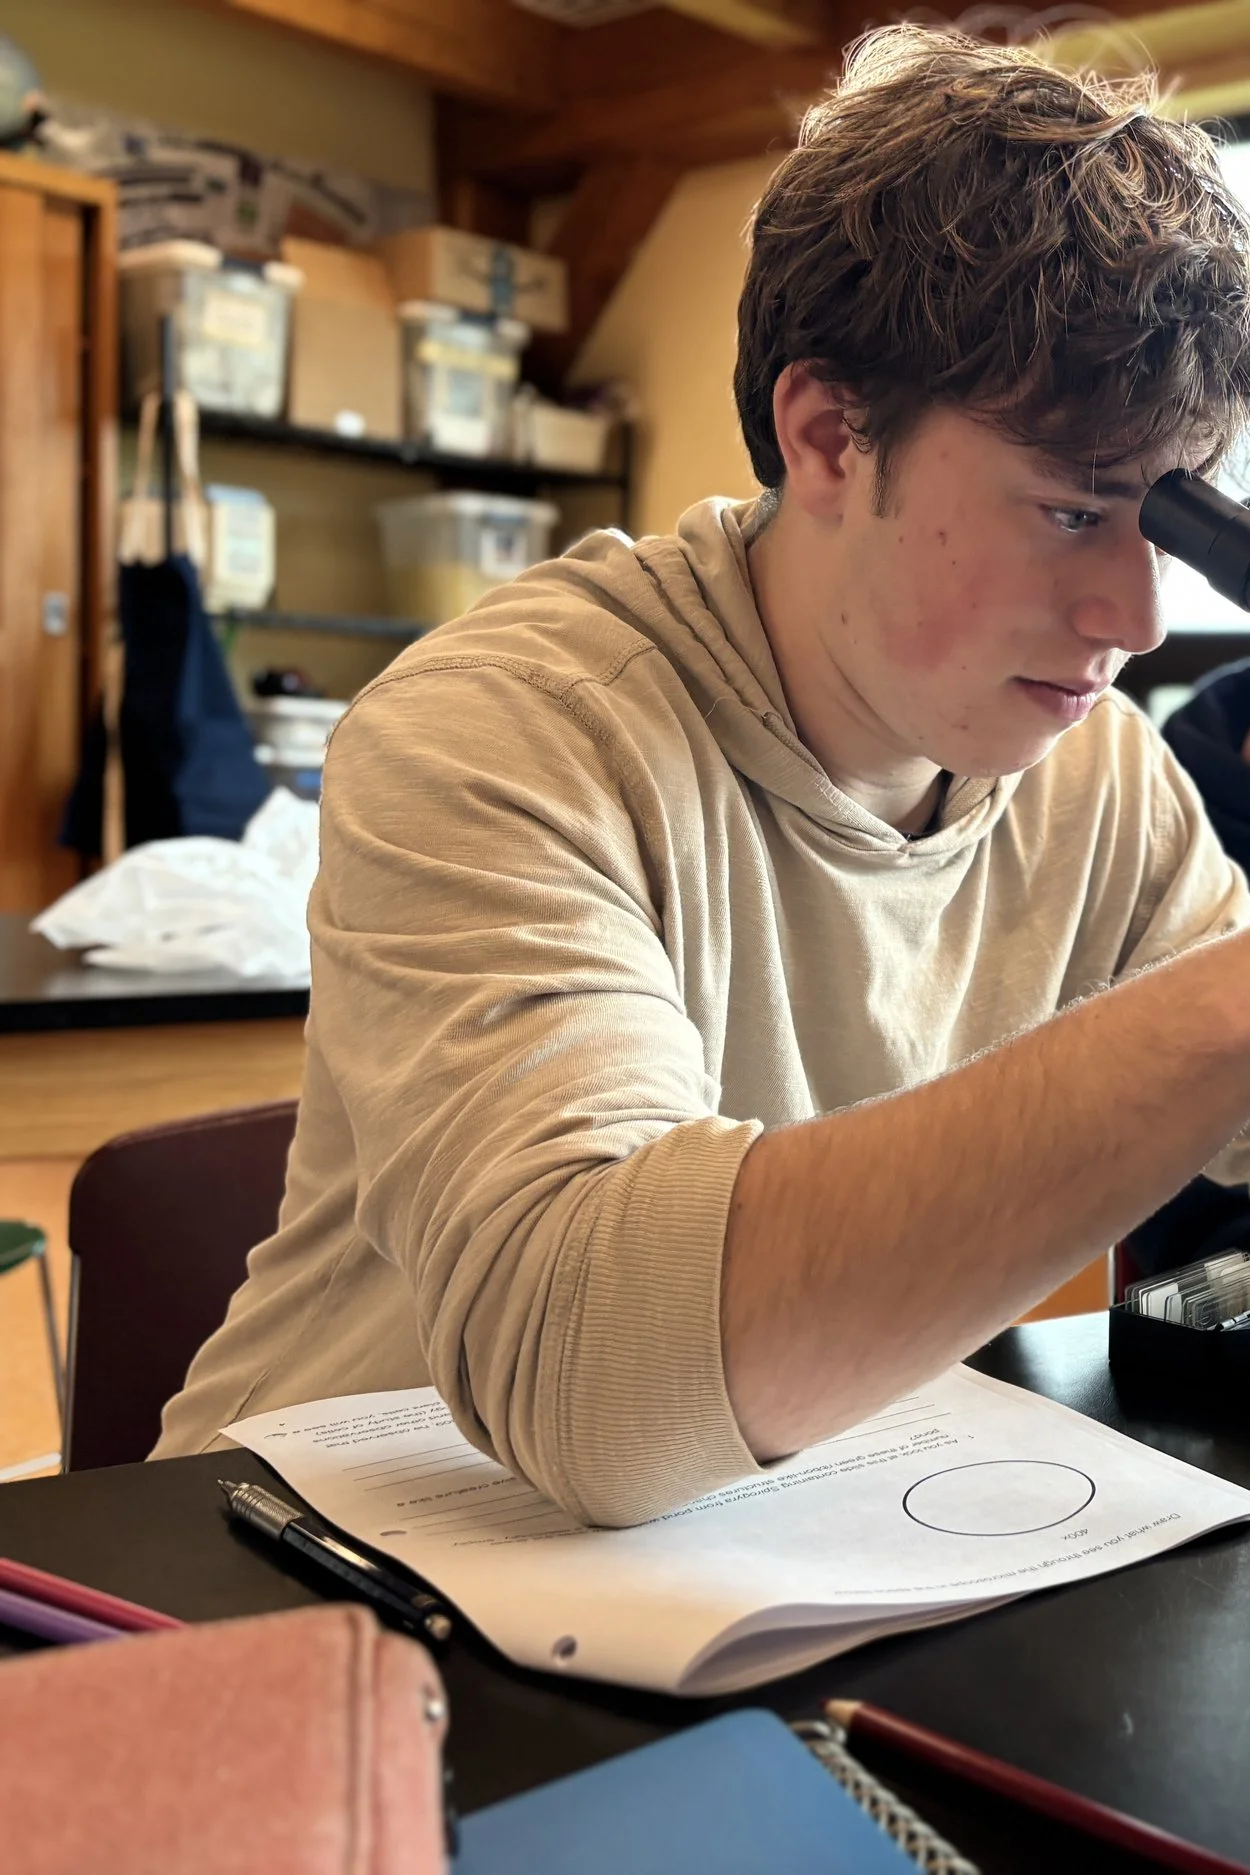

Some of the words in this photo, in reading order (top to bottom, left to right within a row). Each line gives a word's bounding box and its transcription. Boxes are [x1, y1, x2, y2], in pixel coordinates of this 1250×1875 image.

[312, 1425, 392, 1444] observations
[352, 1428, 410, 1444] observed
[912, 1434, 949, 1448] number
[326, 1440, 350, 1449] that
[923, 1441, 943, 1452] you
[834, 1454, 866, 1466] green
[867, 1448, 898, 1458] these
[900, 1448, 922, 1458] look
[839, 1462, 865, 1475] slide
[866, 1456, 886, 1468] this
[777, 1463, 833, 1484] ribbon-like
[780, 1470, 838, 1489] containing
[718, 1478, 775, 1496] structures
[724, 1485, 780, 1504] Spirogyra
[695, 1500, 723, 1512] from
[661, 1507, 693, 1522] pond
[1152, 1512, 1181, 1529] Draw
[1060, 1527, 1088, 1541] 400x
[1123, 1524, 1152, 1541] what
[1103, 1535, 1124, 1548] you
[1082, 1544, 1102, 1556] see
[1037, 1552, 1082, 1570] through
[1017, 1563, 1038, 1574] the
